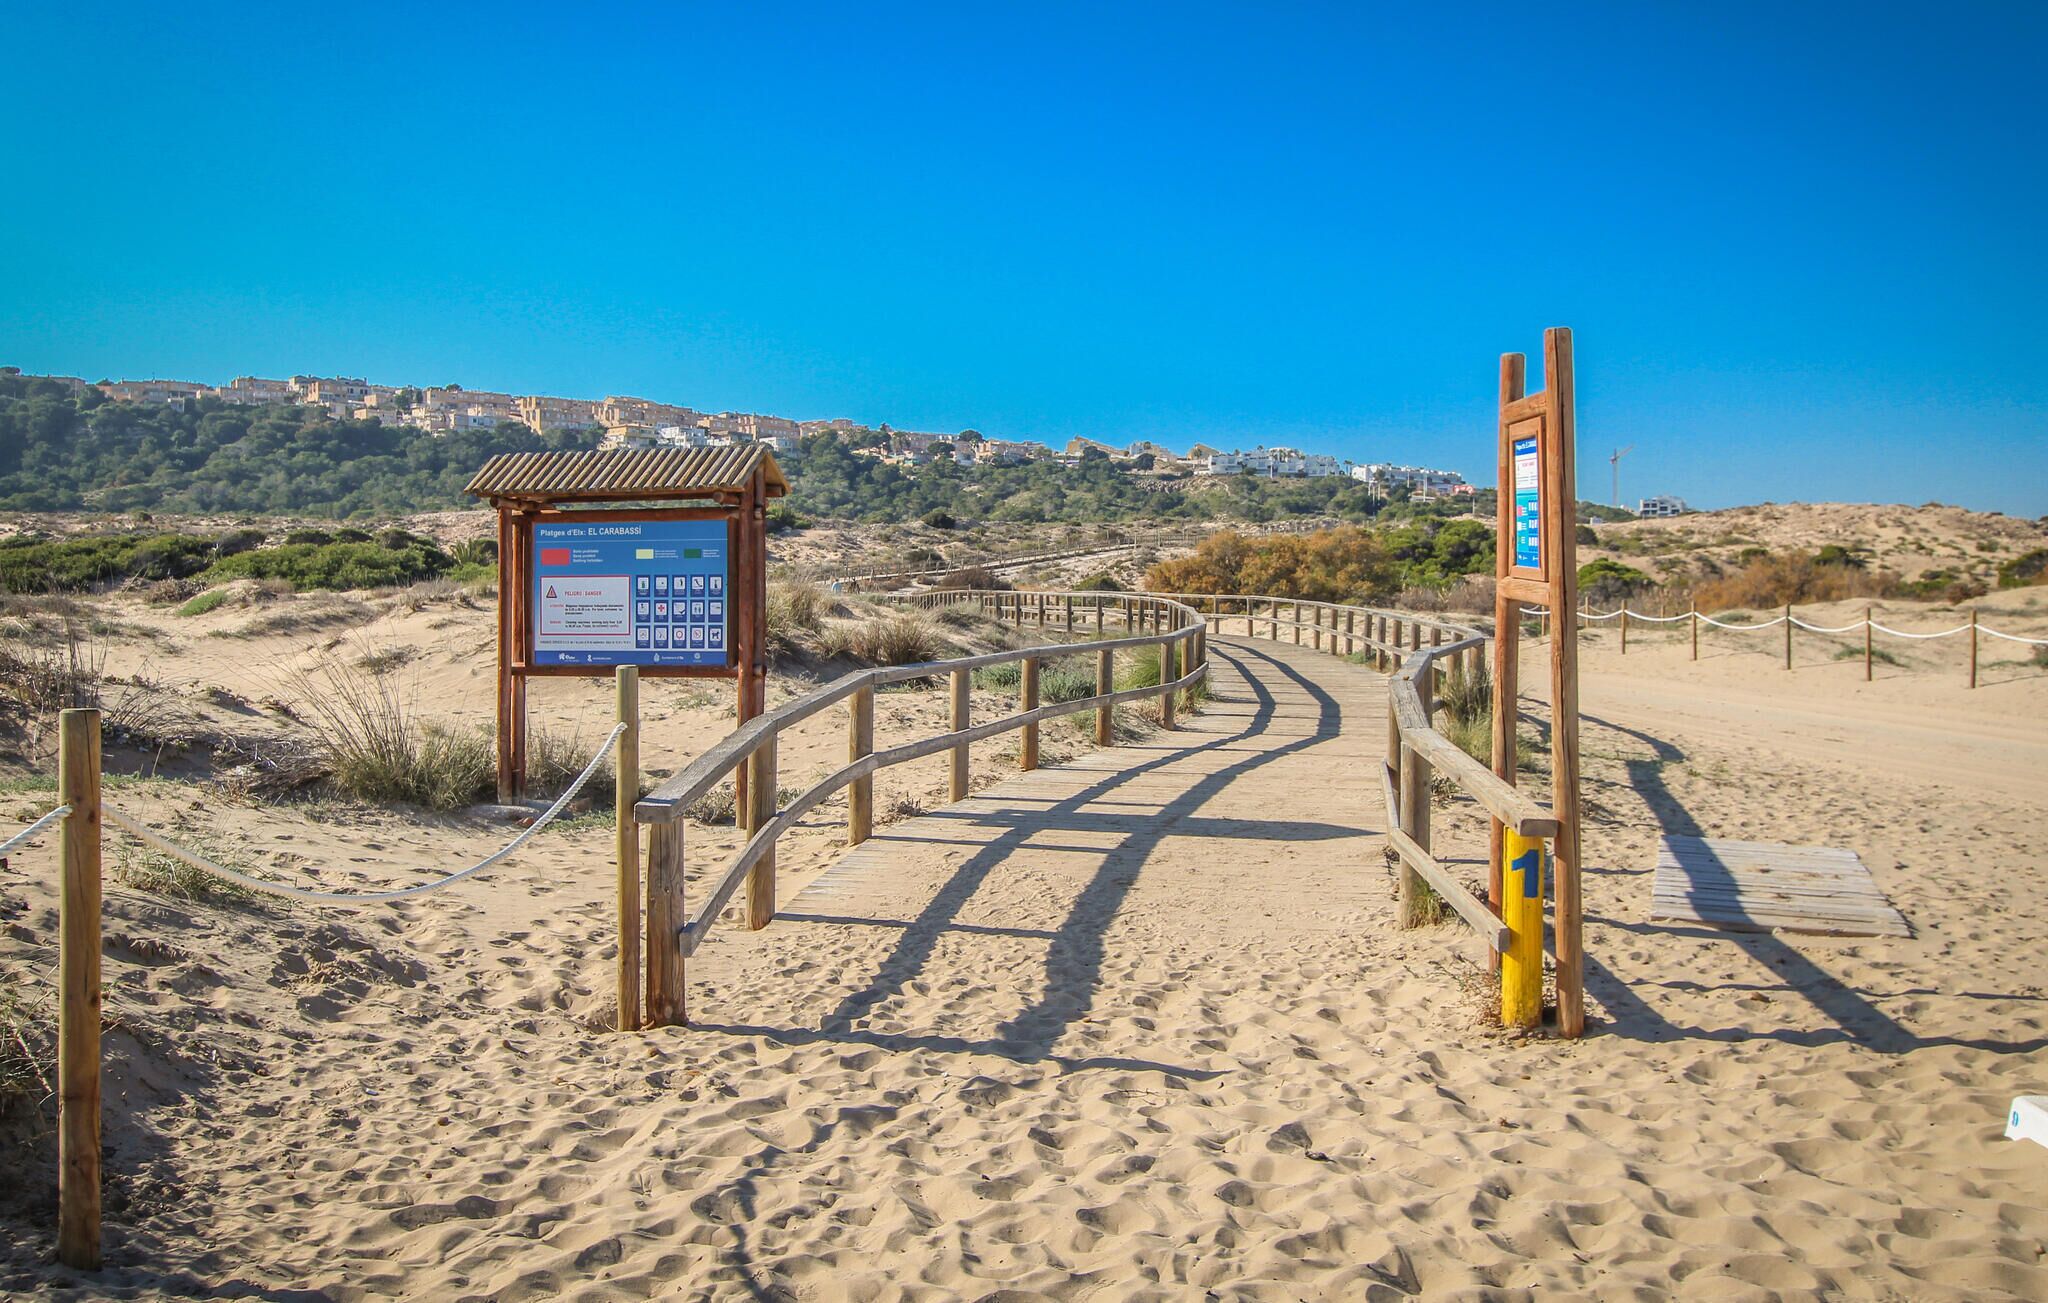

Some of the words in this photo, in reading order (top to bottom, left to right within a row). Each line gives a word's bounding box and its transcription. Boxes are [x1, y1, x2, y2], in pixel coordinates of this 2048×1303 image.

[540, 529, 565, 538] Platges
[588, 527, 598, 536] EL
[1511, 849, 1539, 898] 1
